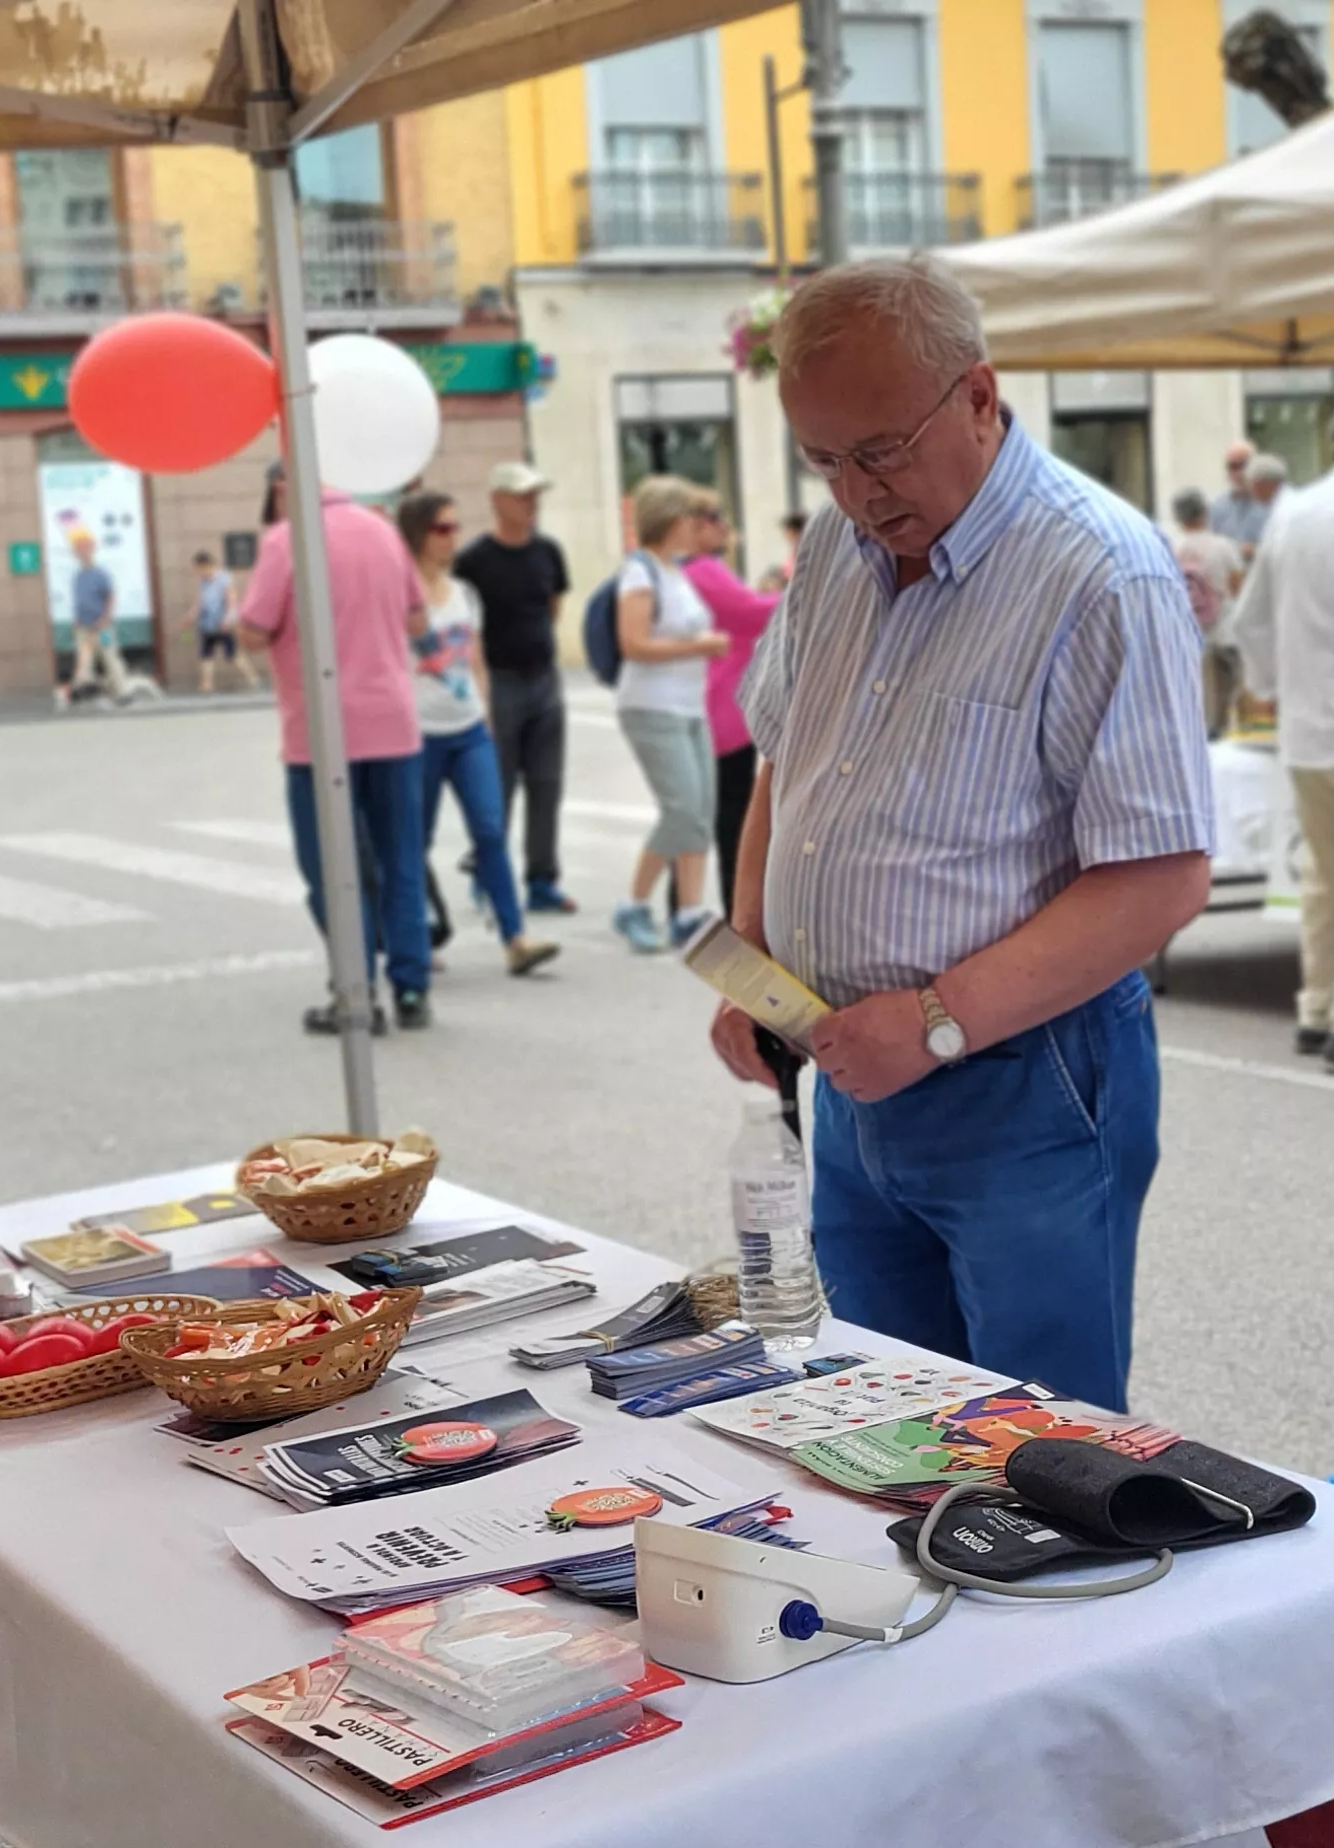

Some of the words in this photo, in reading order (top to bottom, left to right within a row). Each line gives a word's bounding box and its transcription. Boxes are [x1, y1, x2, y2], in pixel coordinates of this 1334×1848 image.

[375, 1531, 450, 1568] PREVENIR
[403, 1525, 454, 1551] ACTUAR
[337, 1718, 433, 1766] PASTILLERO
